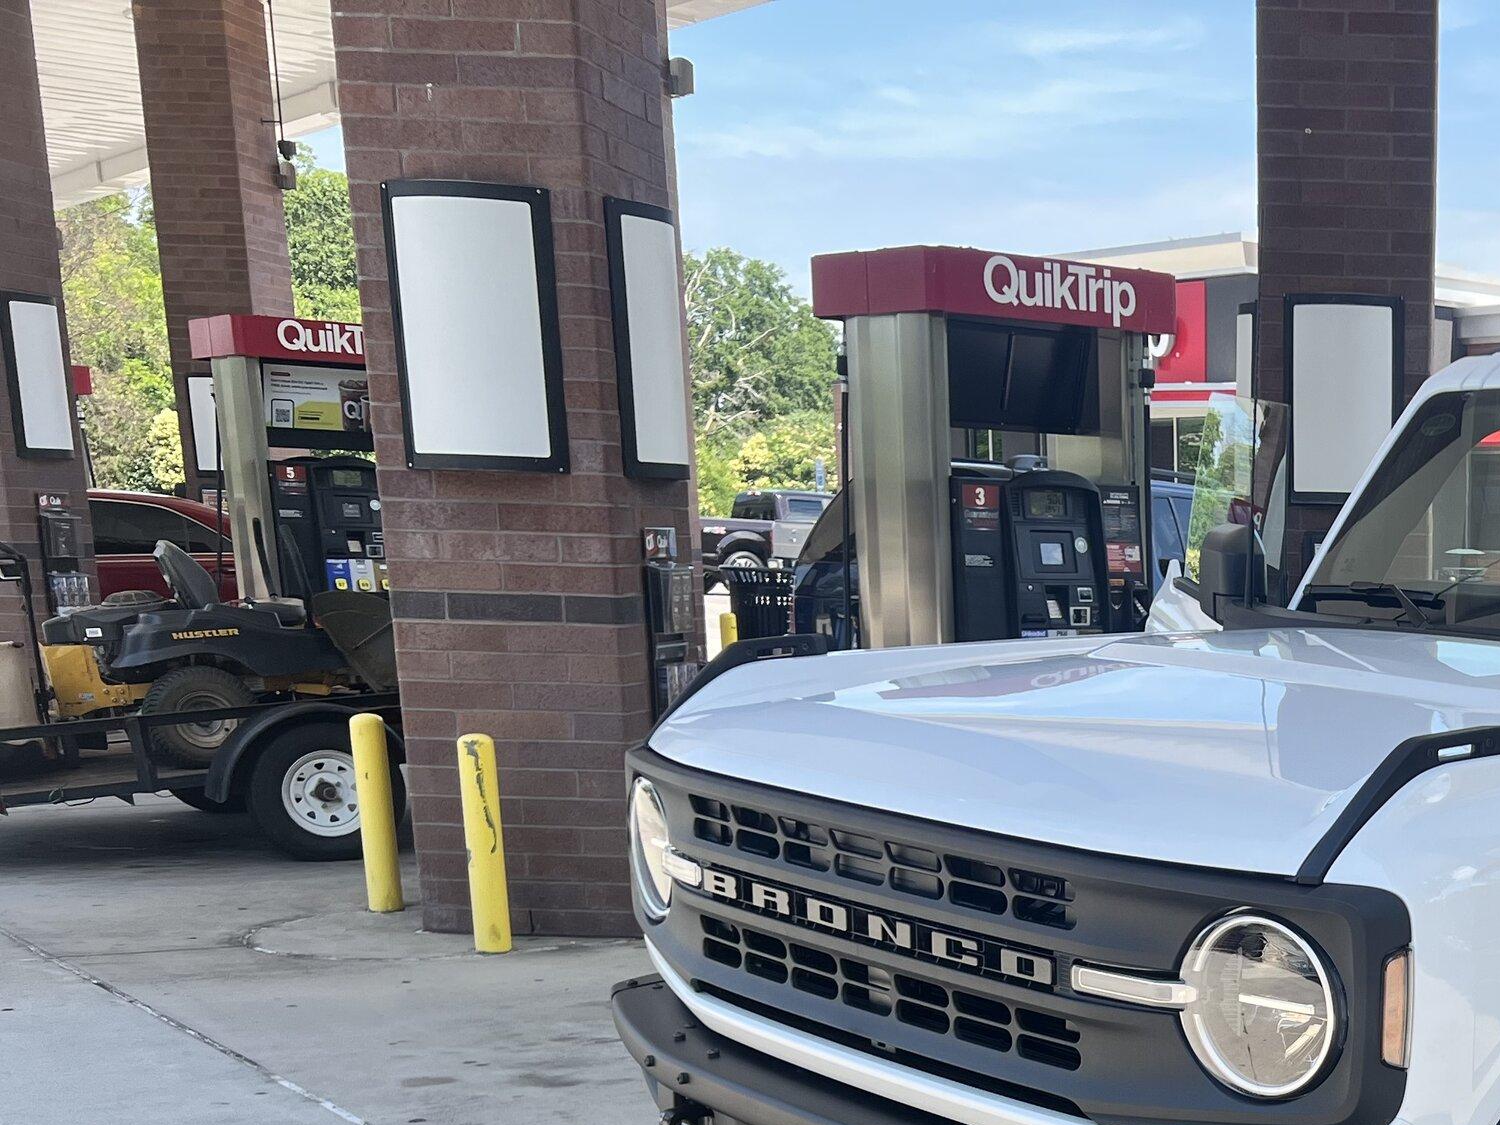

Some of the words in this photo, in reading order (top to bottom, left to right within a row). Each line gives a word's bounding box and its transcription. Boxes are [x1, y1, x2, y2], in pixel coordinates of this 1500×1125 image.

[983, 255, 1137, 328] QuikTrip
[286, 466, 295, 479] 5
[975, 487, 986, 506] 3
[171, 628, 240, 640] HUSTLER
[703, 869, 1054, 986] BRONCO
